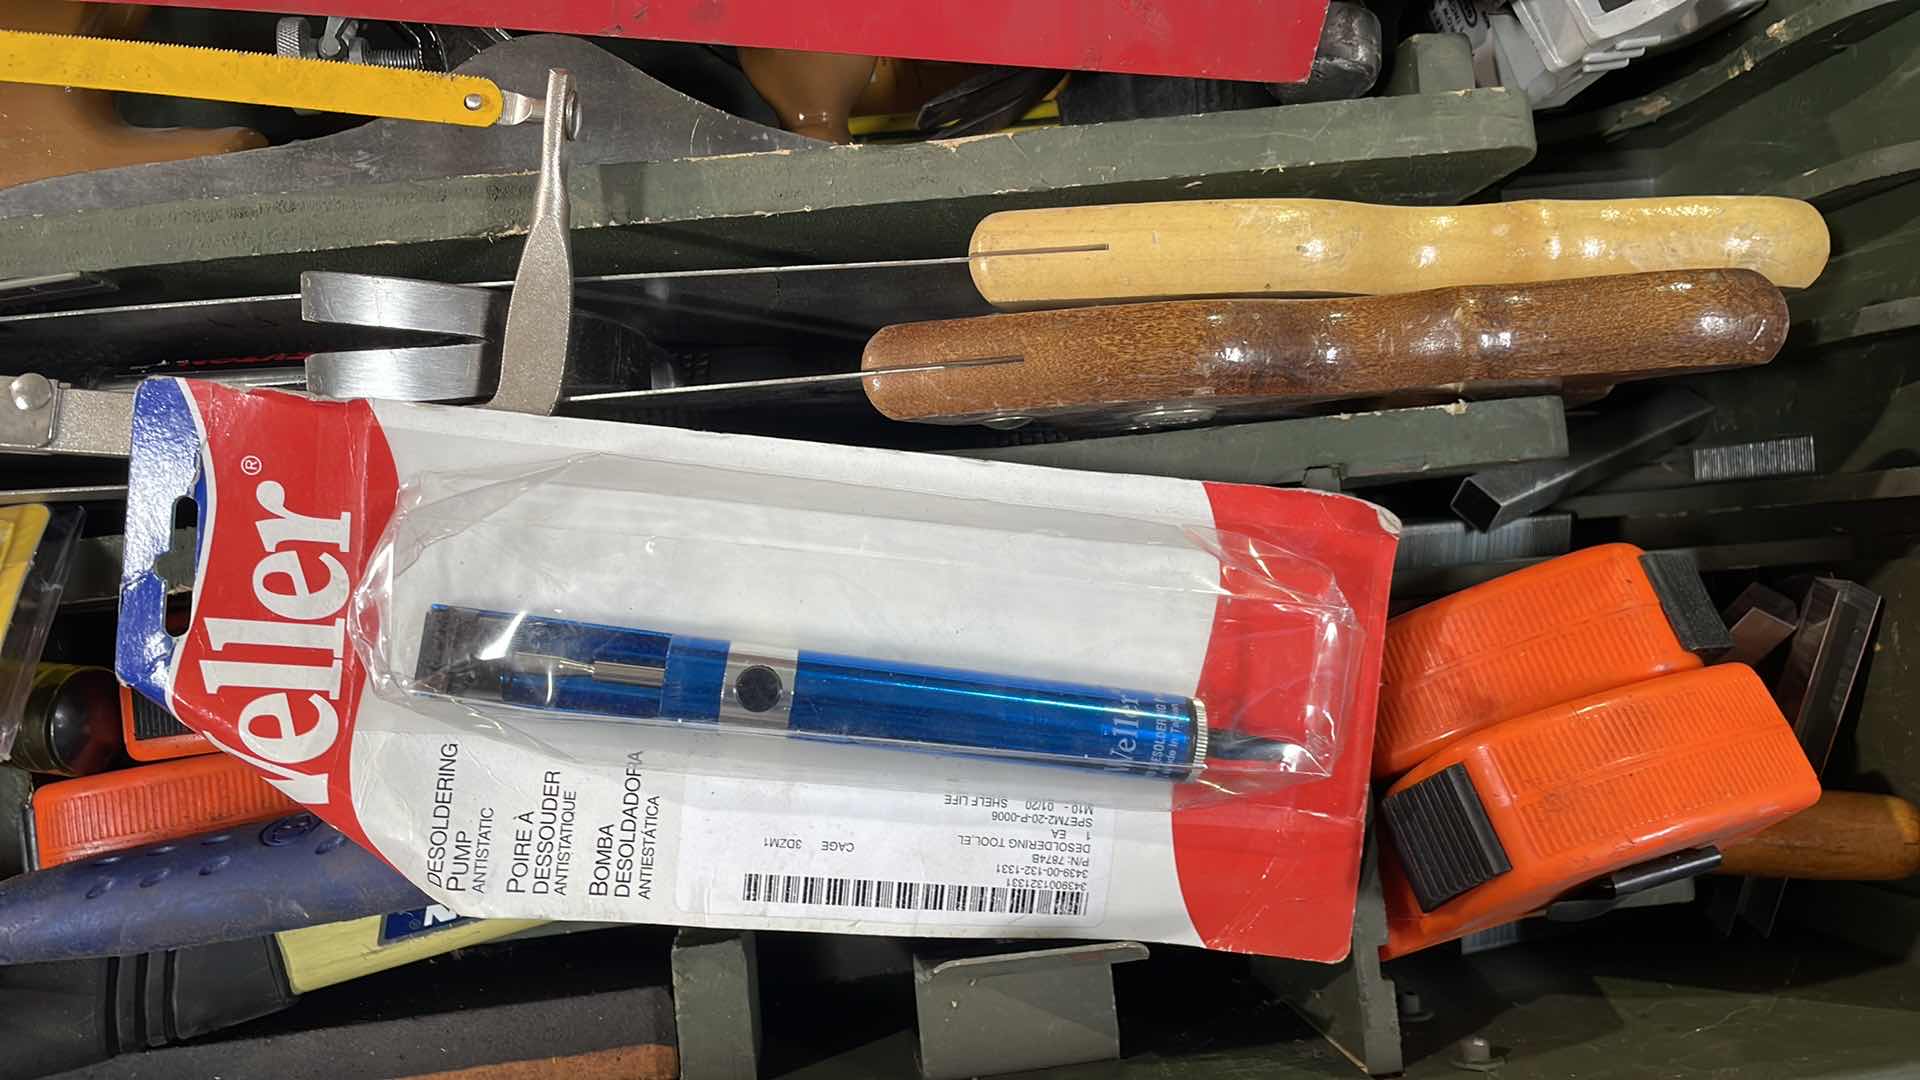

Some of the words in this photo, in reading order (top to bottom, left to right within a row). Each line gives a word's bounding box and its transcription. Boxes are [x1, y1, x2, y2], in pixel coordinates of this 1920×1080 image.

[943, 794, 968, 806] LIFE
[971, 796, 1008, 808] SHELF
[427, 743, 459, 888] DESOLDERING
[513, 811, 535, 825] À
[991, 811, 1093, 827] SPE7M2-20-P-0006
[532, 771, 561, 894] DESSOUDER
[1051, 829, 1066, 839] EA
[1086, 831, 1091, 840] 1
[554, 791, 576, 896] ANTISTATIQUE
[638, 795, 660, 900] ANTIESTÁTICA
[763, 837, 802, 849] 3DZM1
[821, 840, 855, 852] CAGE
[1008, 839, 1091, 853] DESOLDERING
[471, 807, 494, 894] ANTISTATIC
[446, 830, 472, 891] PUMP
[506, 829, 532, 893] POIRE
[588, 824, 615, 896] BOMBA
[1032, 853, 1064, 865] 7874B
[1066, 856, 1090, 867] P/N:
[996, 864, 1089, 878] 3439-00-132-1331
[1006, 878, 1088, 891] 3439001321331
